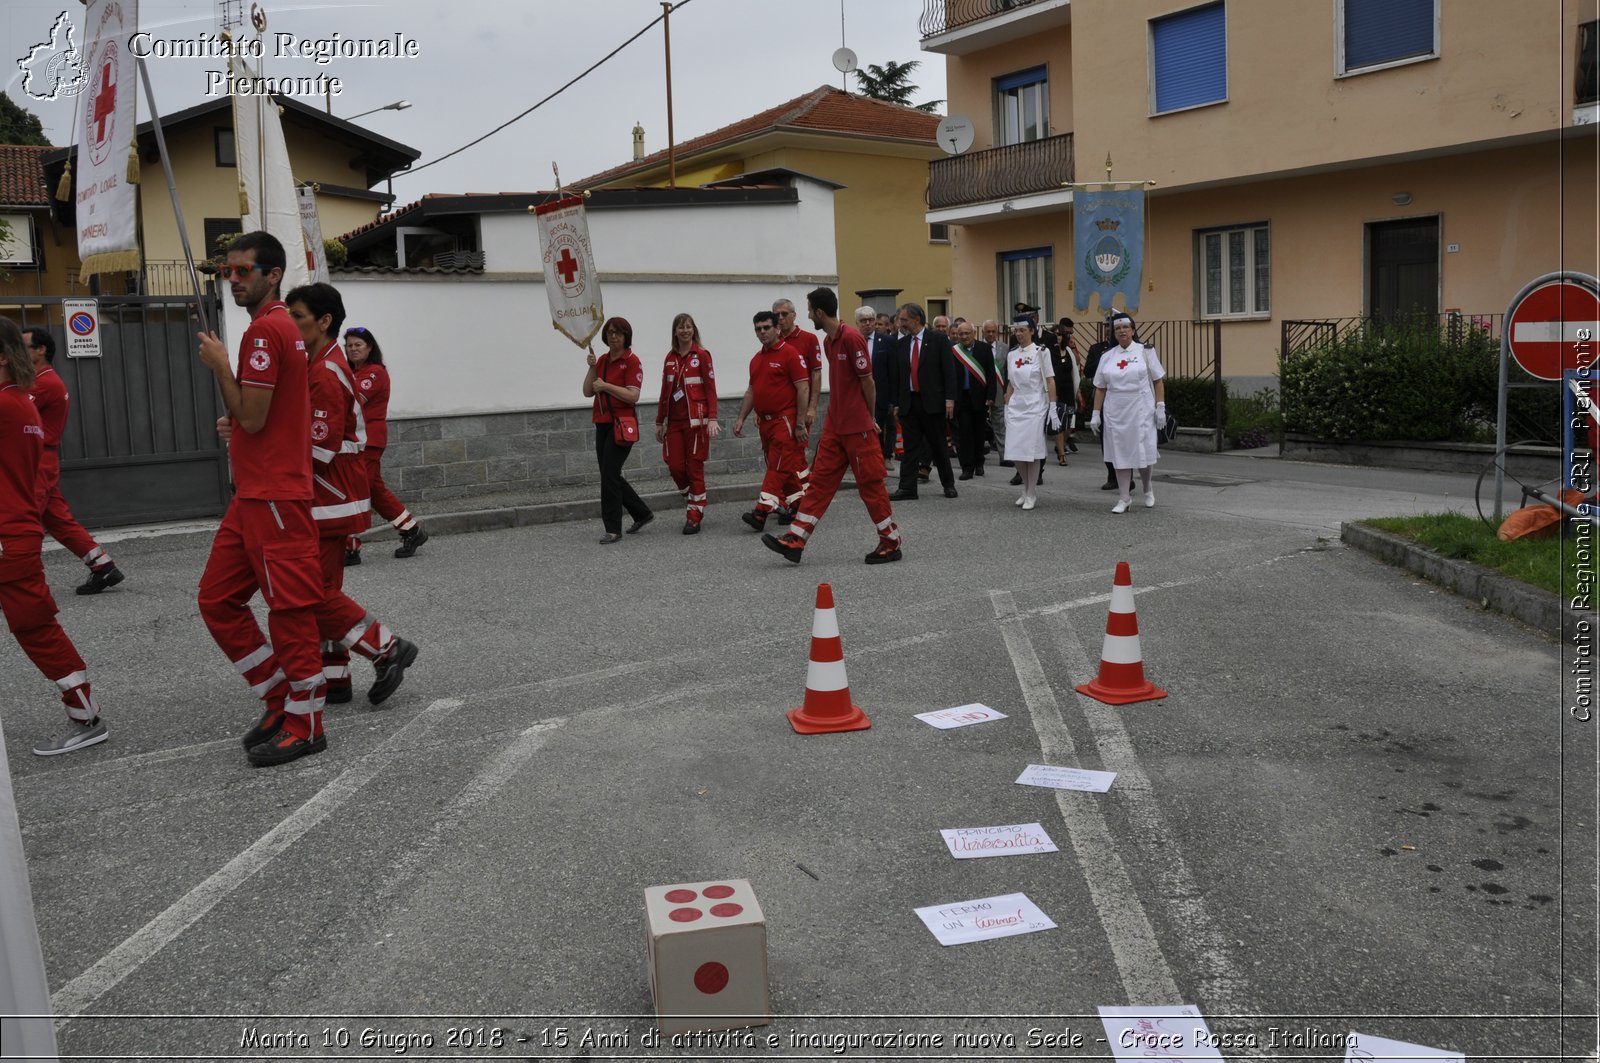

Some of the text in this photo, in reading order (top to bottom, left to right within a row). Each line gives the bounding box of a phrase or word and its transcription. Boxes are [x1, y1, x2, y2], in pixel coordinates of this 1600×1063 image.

[952, 711, 989, 724] END
[956, 825, 1022, 836] PRINCIPIO
[939, 902, 992, 918] FERMO
[942, 919, 965, 930] UN
